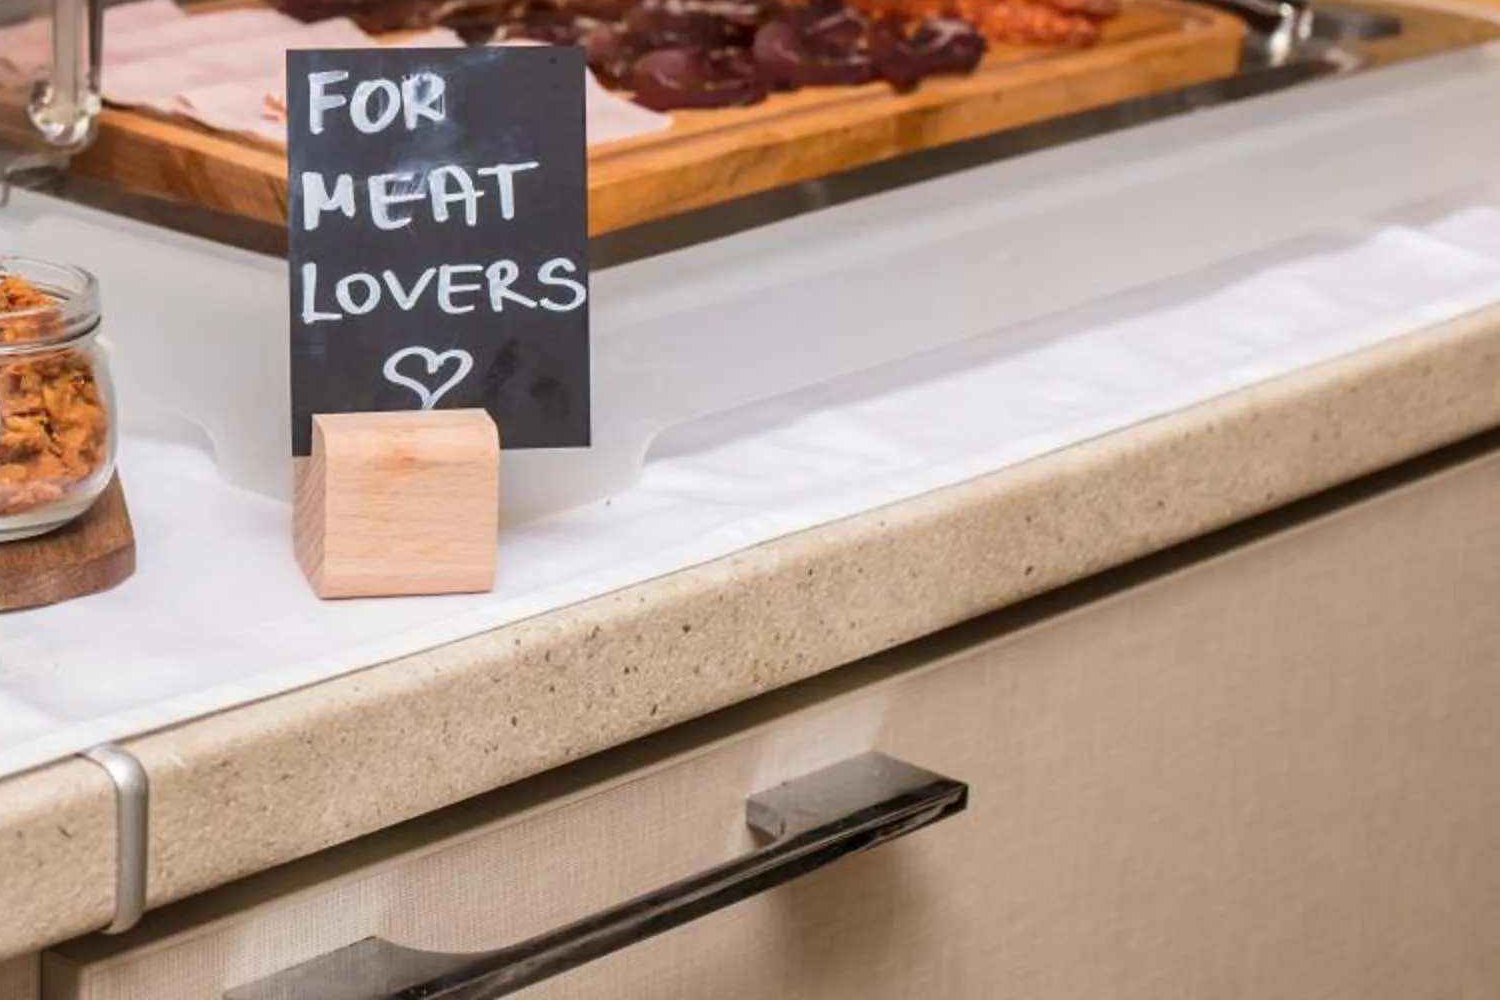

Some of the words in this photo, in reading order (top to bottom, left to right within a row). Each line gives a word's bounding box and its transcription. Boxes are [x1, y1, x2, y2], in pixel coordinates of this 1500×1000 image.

[308, 70, 446, 136] FOR
[302, 161, 540, 231] MEAT
[302, 257, 587, 324] LOVERS
